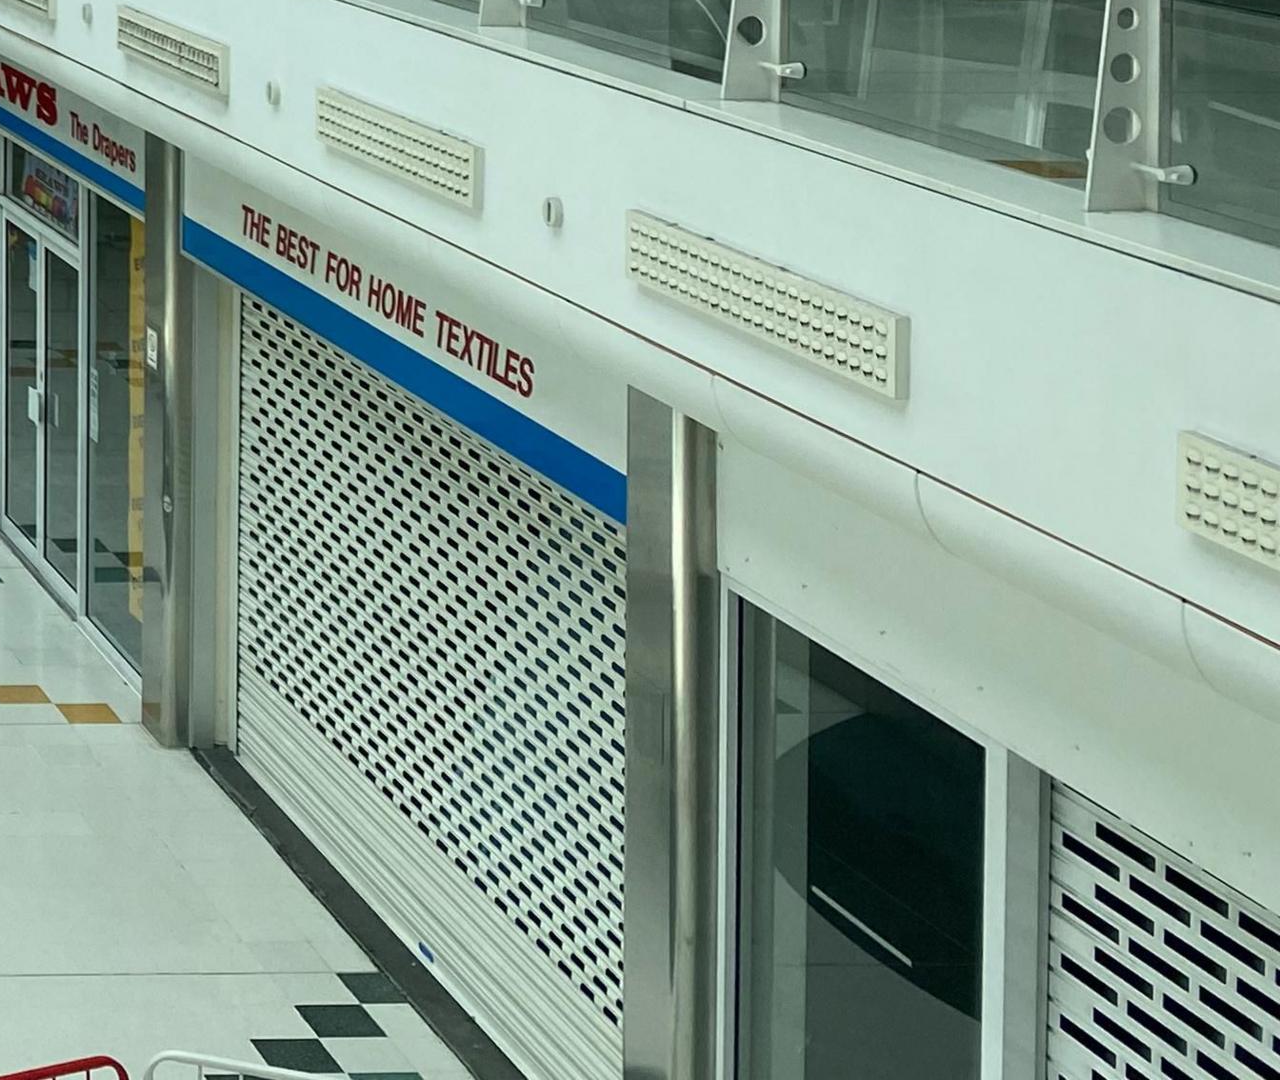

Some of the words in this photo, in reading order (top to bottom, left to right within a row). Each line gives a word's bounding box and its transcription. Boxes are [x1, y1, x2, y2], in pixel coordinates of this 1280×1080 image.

[70, 110, 89, 146] The
[93, 123, 137, 173] Drapers
[242, 204, 271, 249] THE
[276, 223, 320, 275] BEST
[325, 251, 362, 301] FOR
[368, 274, 427, 338] HOME
[435, 310, 535, 398] TEXTILES
